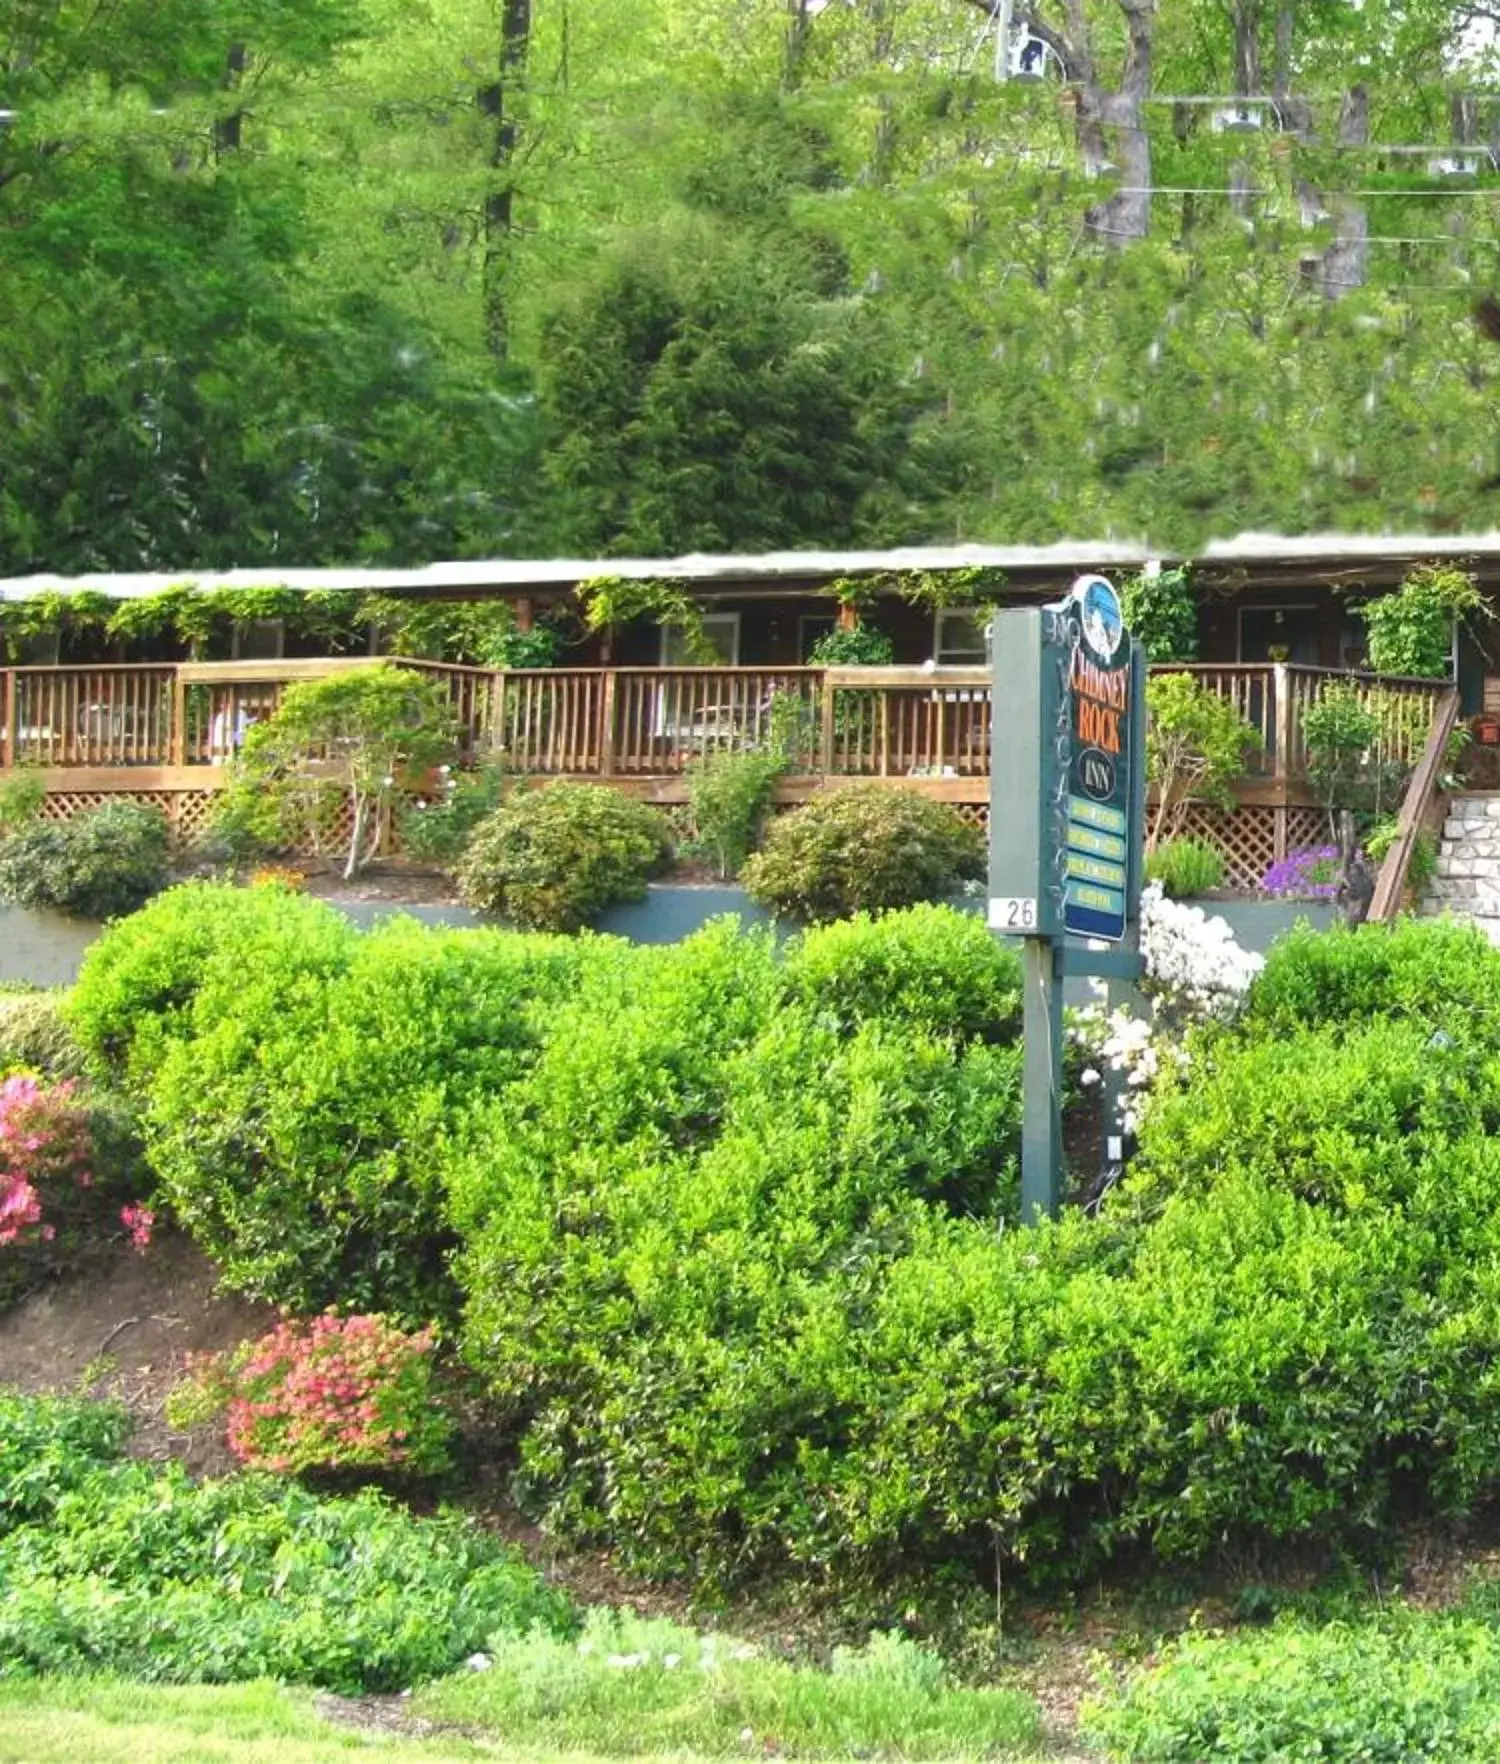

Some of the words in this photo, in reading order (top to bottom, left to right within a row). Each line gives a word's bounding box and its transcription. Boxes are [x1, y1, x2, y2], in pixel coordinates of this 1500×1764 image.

[1070, 648, 1130, 711] CHIMNEY
[1079, 699, 1121, 753] ROCK
[1085, 759, 1110, 793] INN
[1007, 900, 1034, 926] 26
